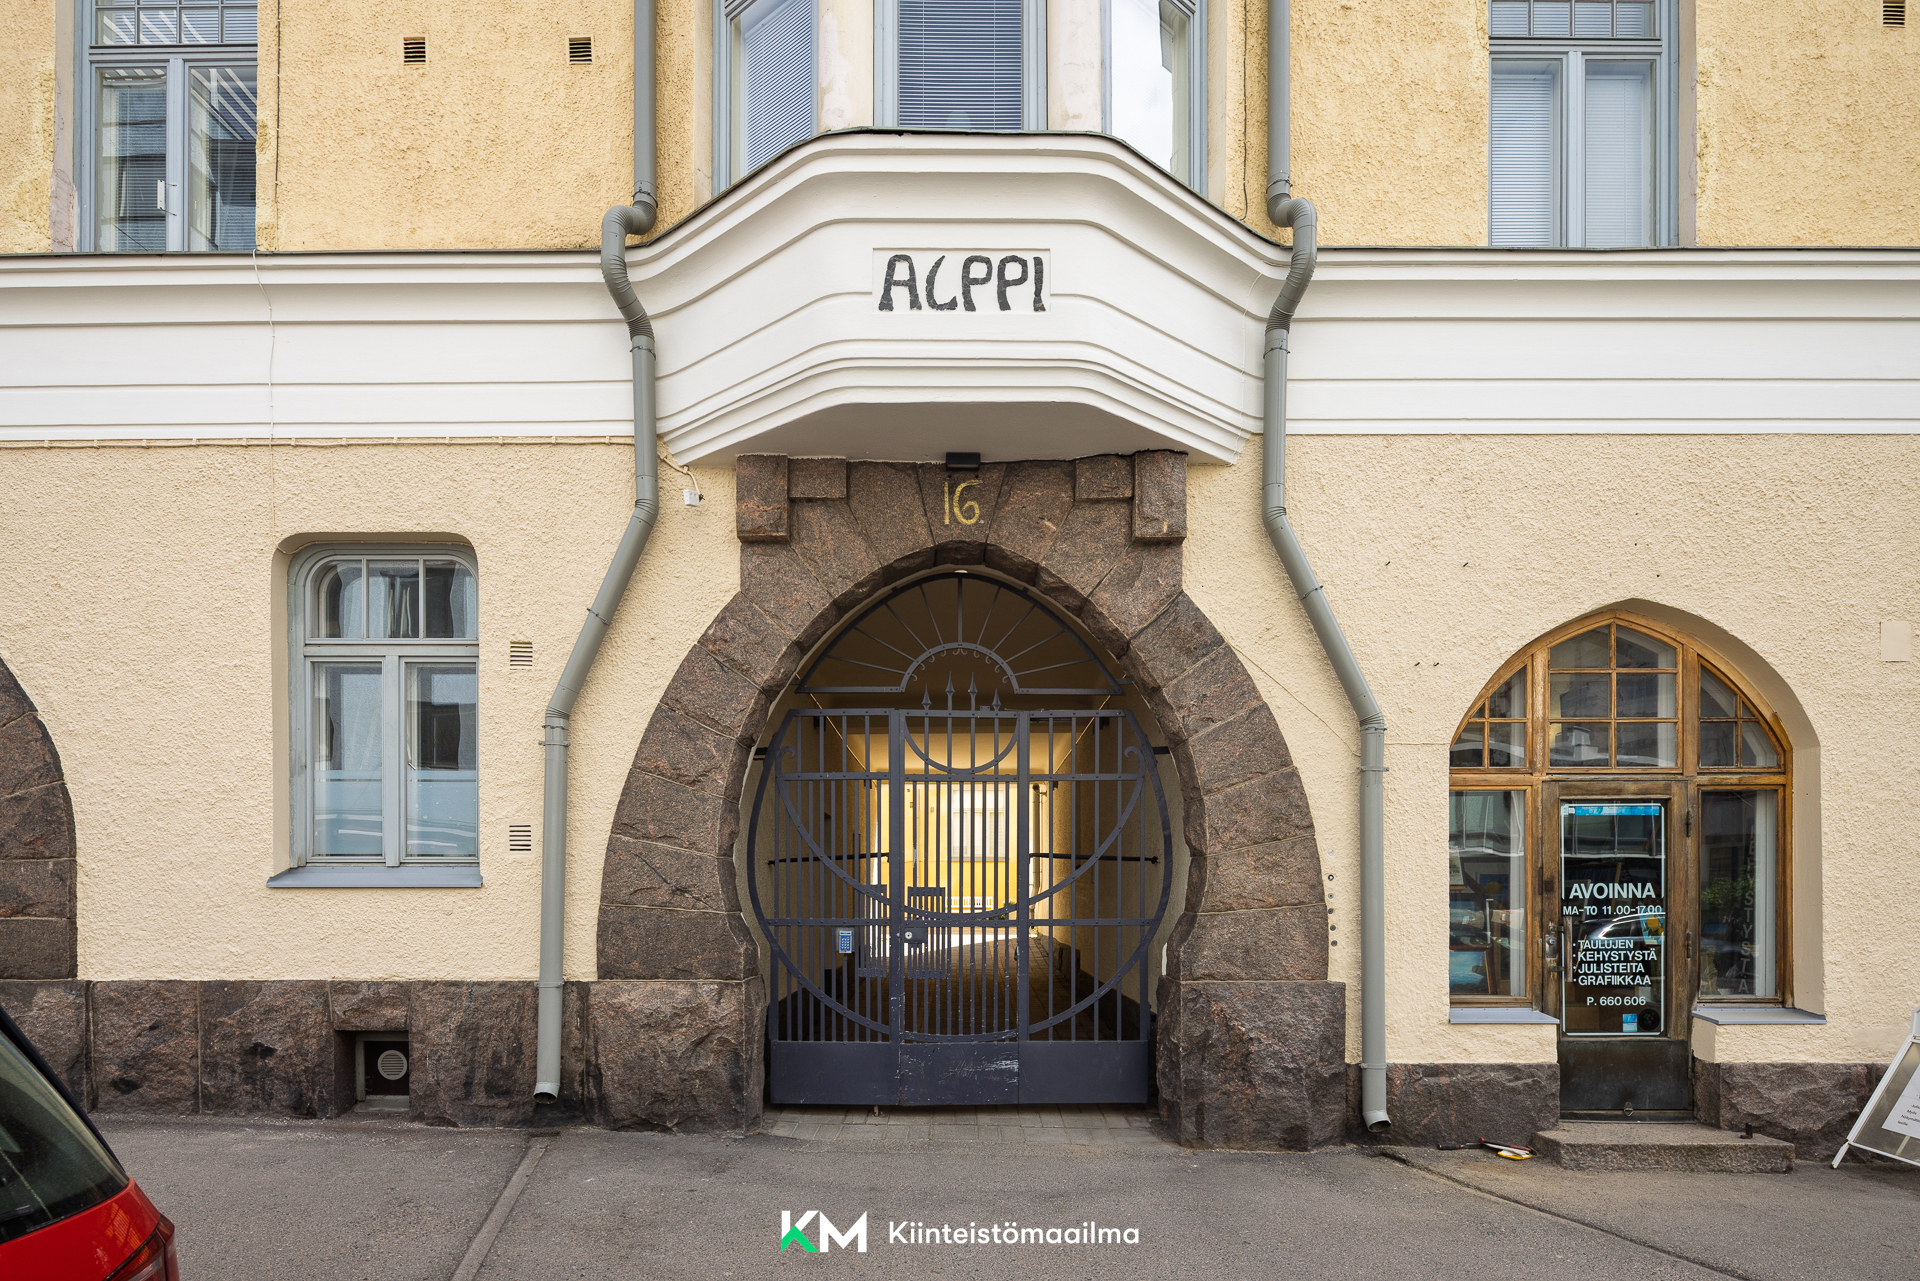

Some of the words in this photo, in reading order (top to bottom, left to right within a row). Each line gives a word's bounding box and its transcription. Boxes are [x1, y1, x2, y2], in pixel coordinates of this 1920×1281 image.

[878, 254, 1047, 312] ALPPI
[943, 480, 981, 525] 16
[1568, 882, 1656, 899] AVOINNA
[1578, 940, 1634, 949] TAULUJEN
[1577, 948, 1657, 961] KEHYSTYSTÄ
[1577, 963, 1645, 974] JULISTEITA
[1578, 975, 1651, 986] GRAFIIKKAA
[1586, 996, 1597, 1006] P.
[1599, 996, 1622, 1006] 660
[1624, 996, 1647, 1006] 606
